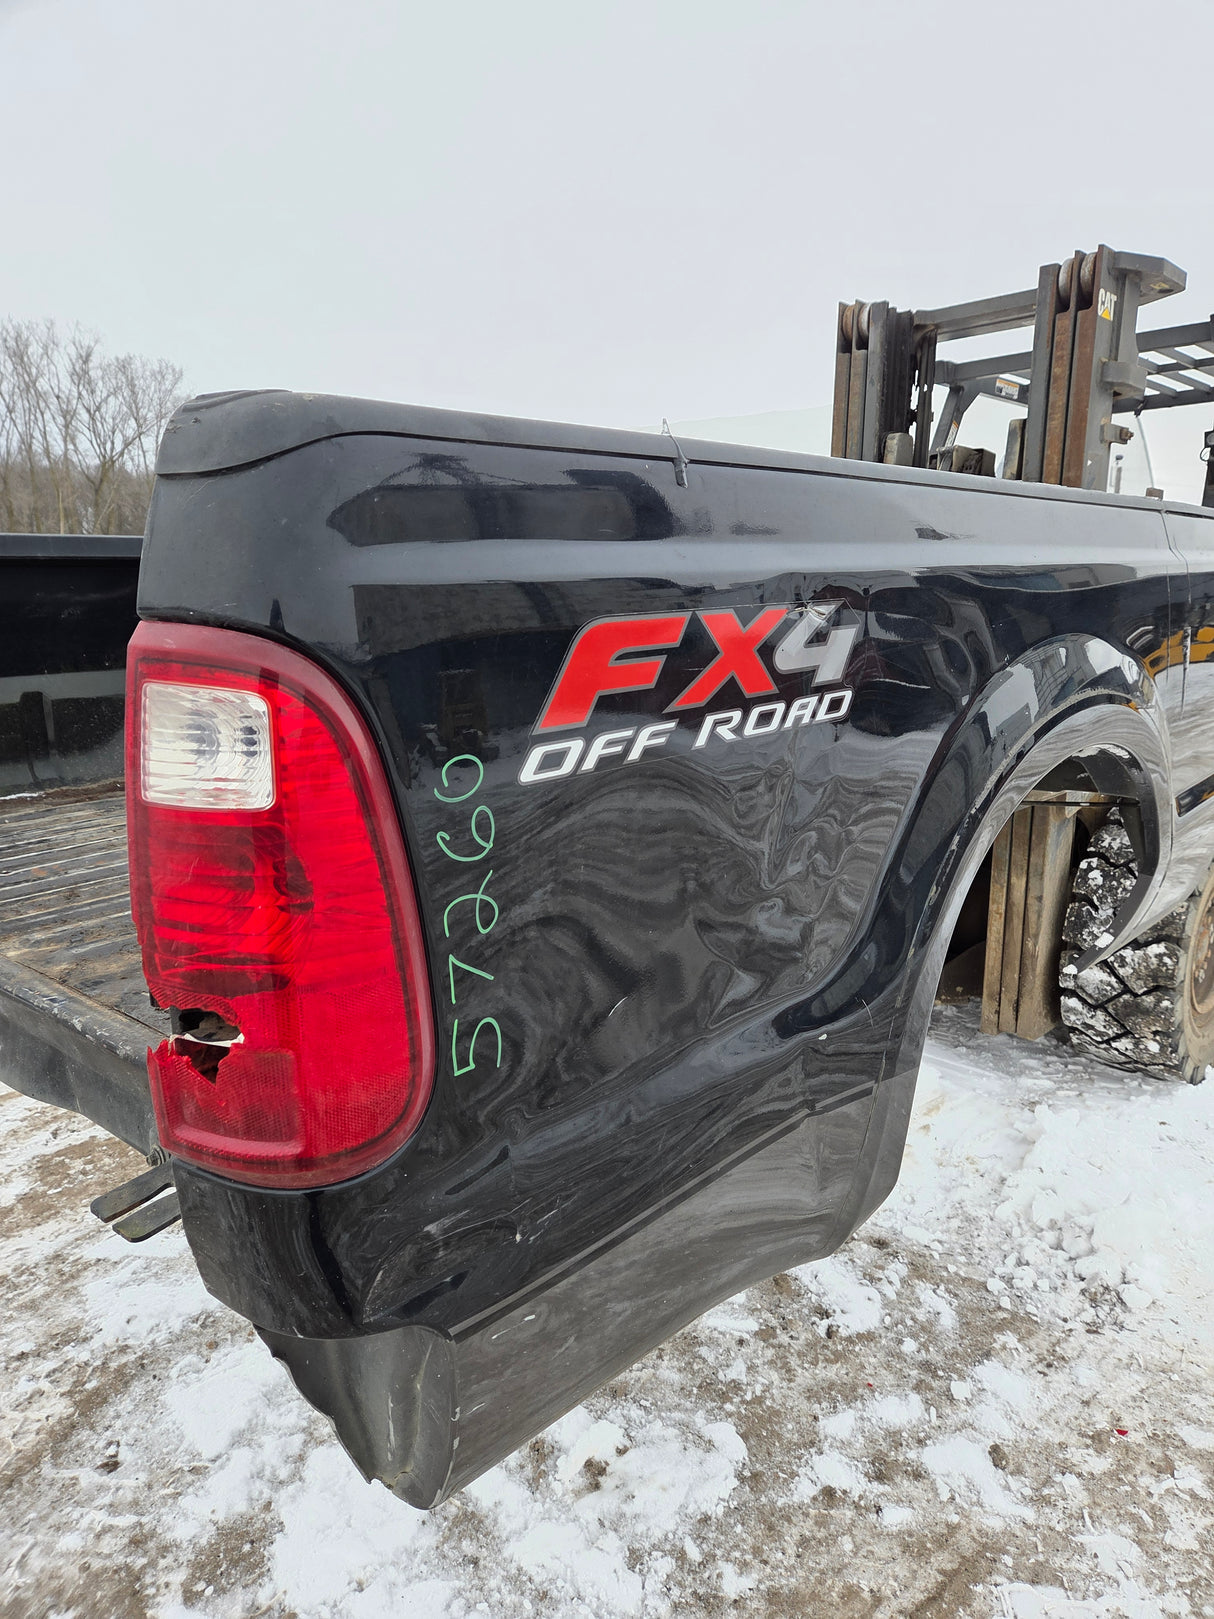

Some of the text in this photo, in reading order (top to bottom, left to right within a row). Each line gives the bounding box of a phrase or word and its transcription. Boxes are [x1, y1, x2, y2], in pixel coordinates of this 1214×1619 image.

[1097, 288, 1117, 322] CAT
[532, 602, 858, 735] FX4
[517, 688, 853, 785] OFF ROAD
[434, 753, 502, 1077] 57260
